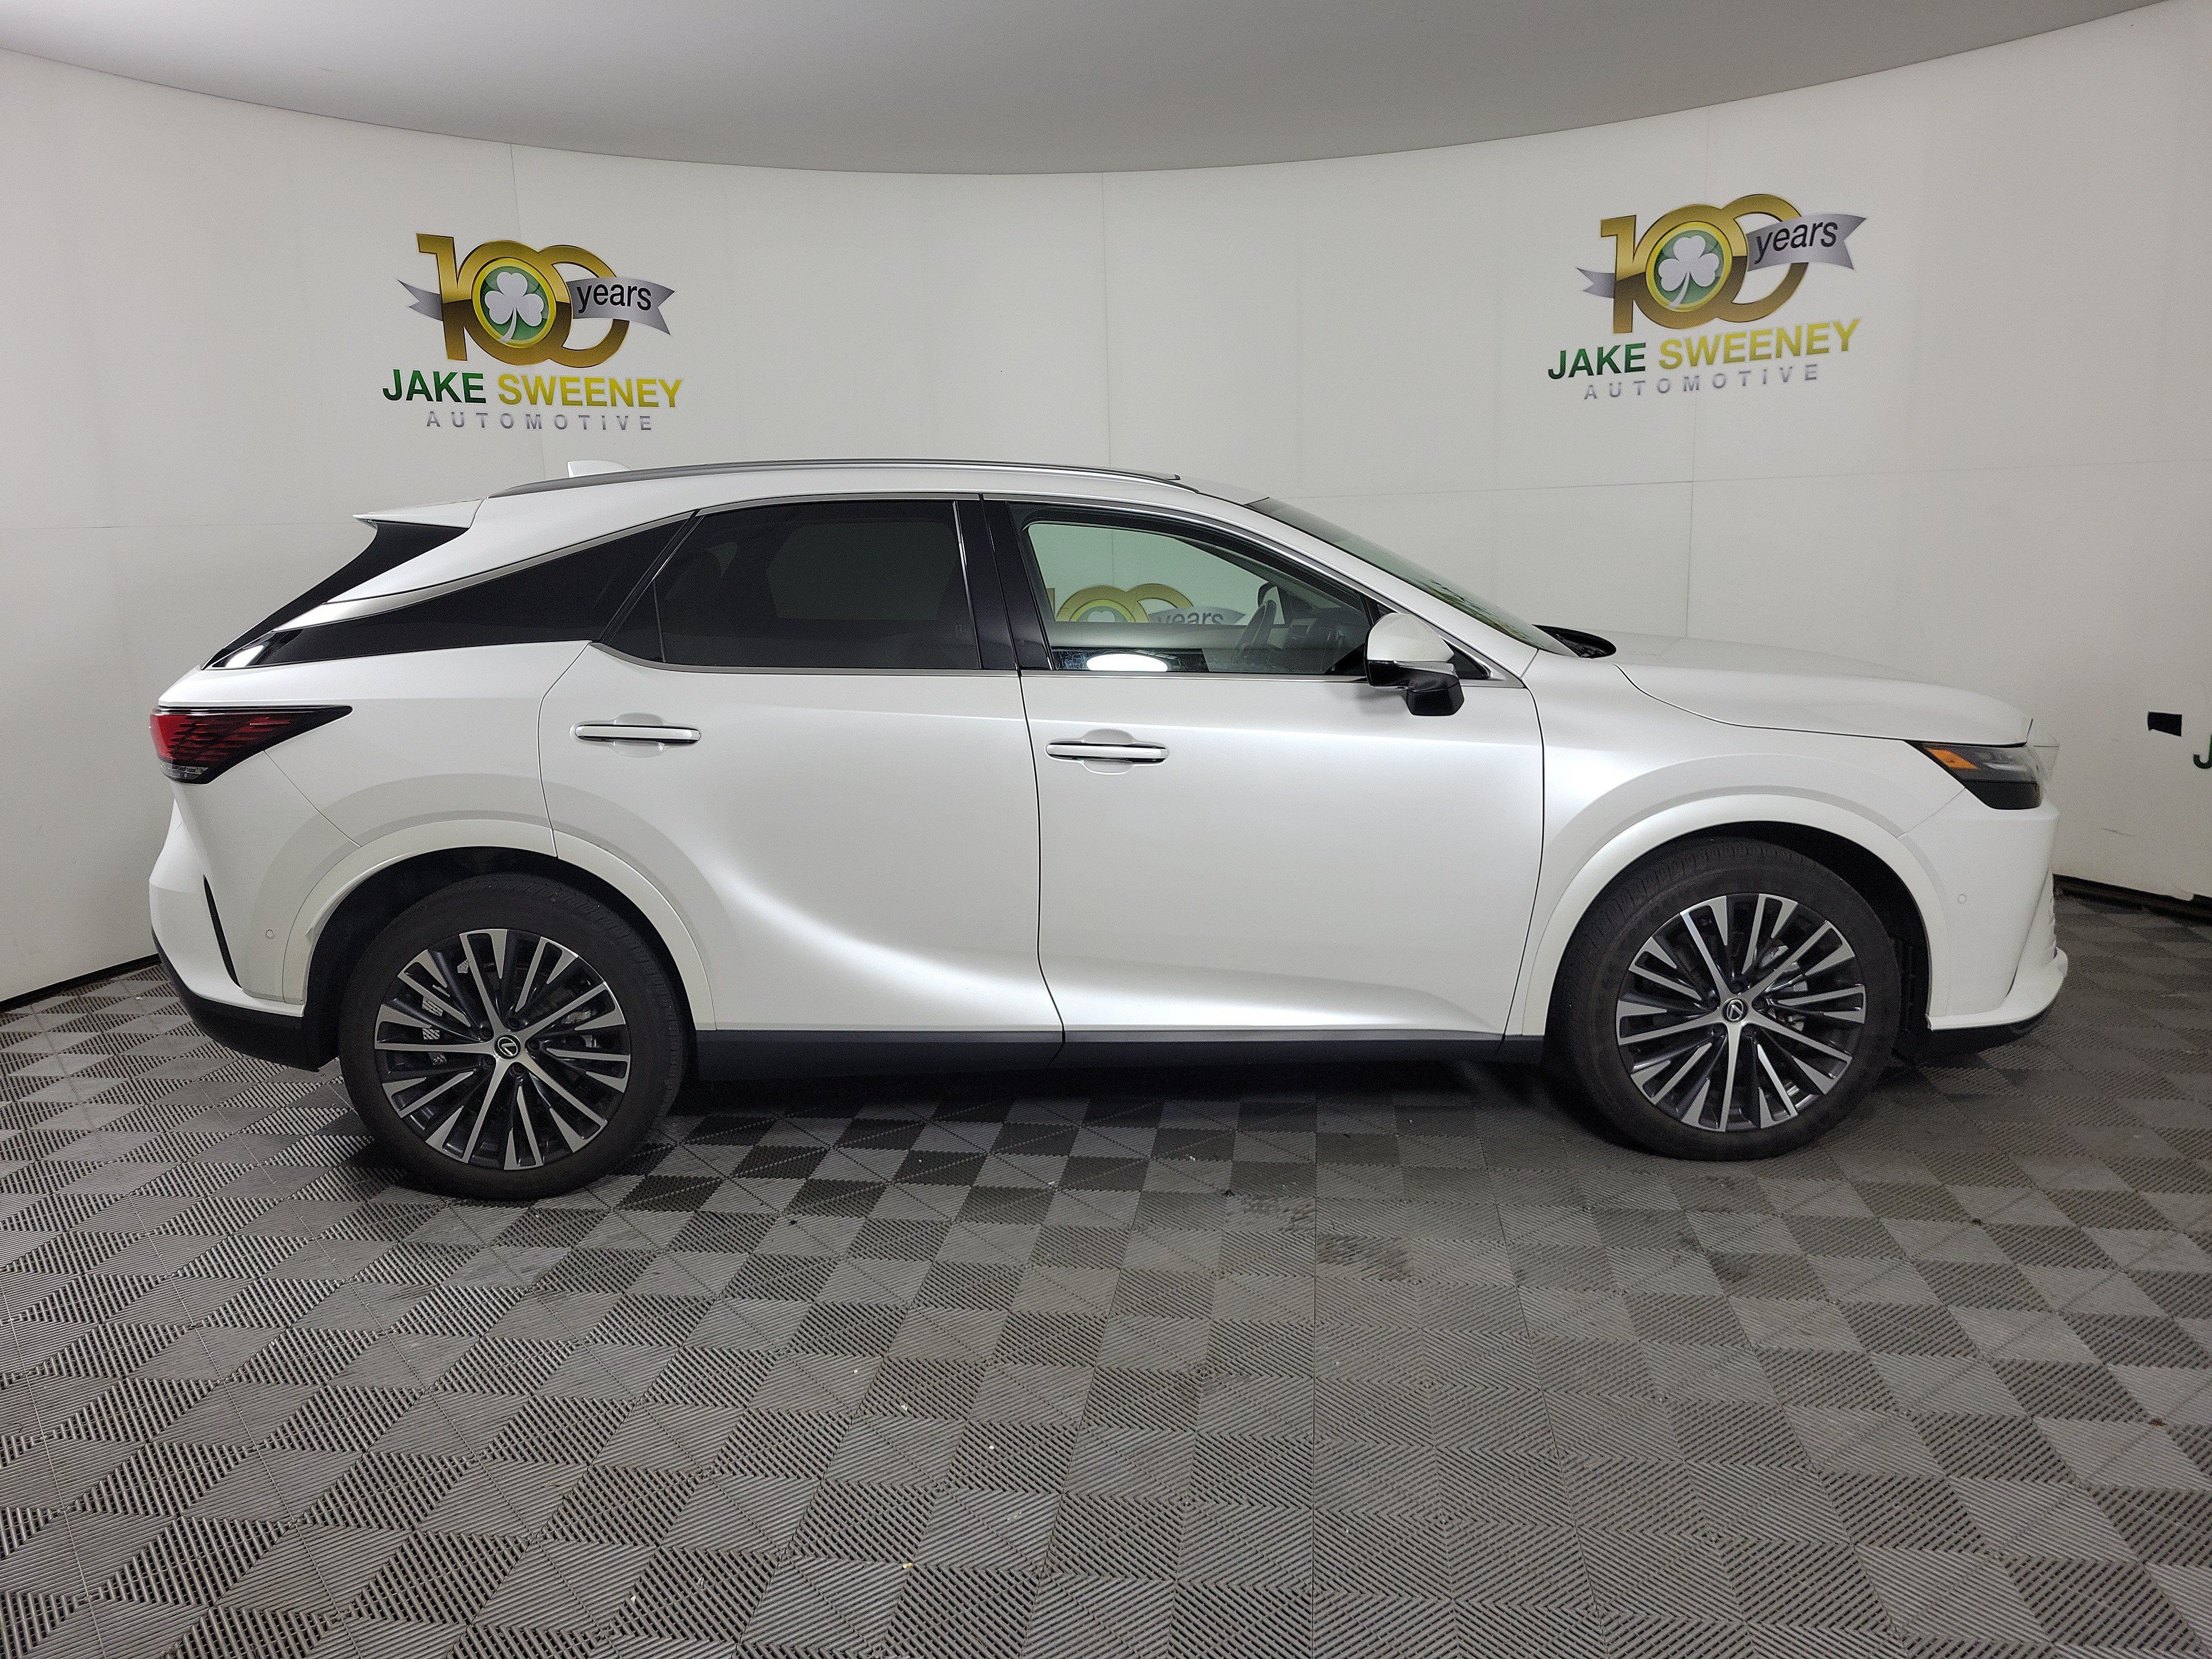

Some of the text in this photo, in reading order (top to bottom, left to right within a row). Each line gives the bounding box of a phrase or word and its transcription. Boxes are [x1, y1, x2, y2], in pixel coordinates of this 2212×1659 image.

[1600, 193, 1838, 335] 100 years
[415, 233, 652, 368] 100 years
[1547, 318, 1861, 380] JAKE SWEENEY
[382, 369, 682, 408] JAKE SWEENEY
[1583, 364, 1818, 400] AUTOMOTIVE
[426, 410, 652, 431] AUTOMOTIVE
